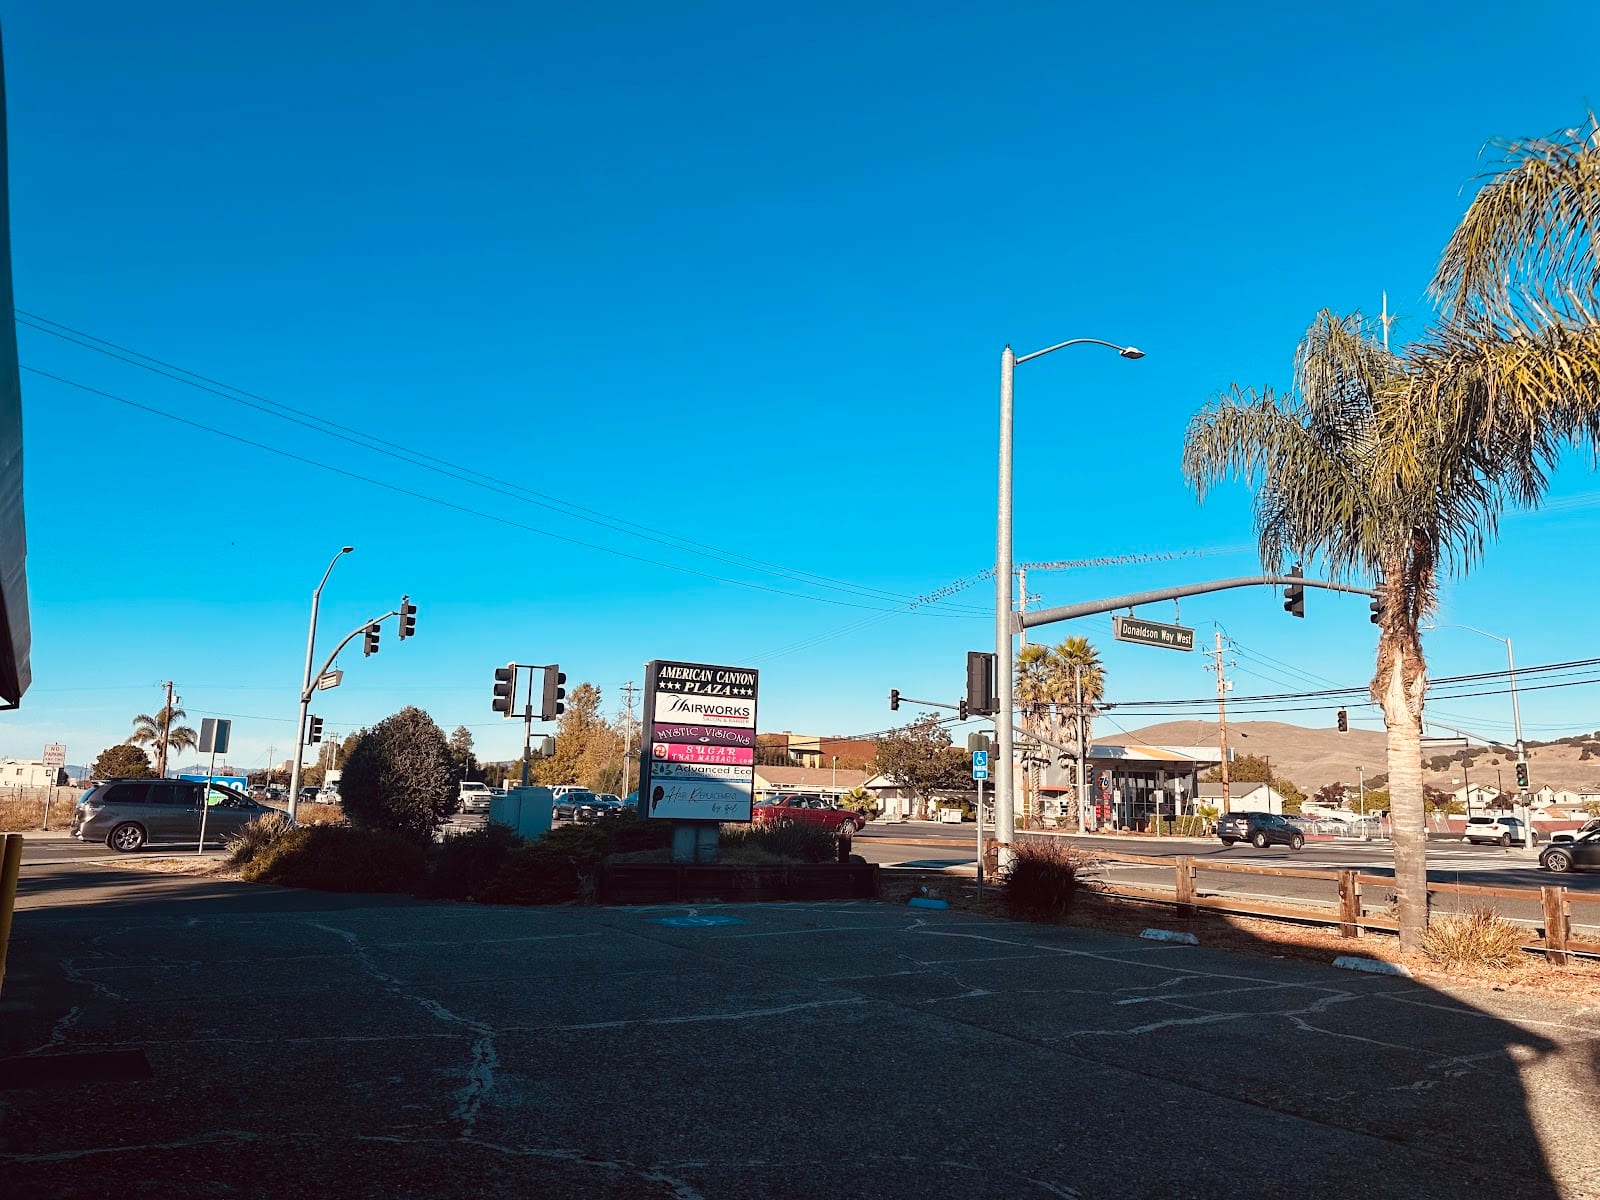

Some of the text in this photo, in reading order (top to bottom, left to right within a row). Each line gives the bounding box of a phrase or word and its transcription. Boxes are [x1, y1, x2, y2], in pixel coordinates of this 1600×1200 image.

[1122, 623, 1192, 645] Donaldson Way West
[659, 665, 755, 686] AMERICAN CANYON
[683, 681, 731, 696] PLAZA
[667, 695, 750, 717] HAIRWORKS
[657, 727, 751, 745] MYSTIC VISIONS
[685, 745, 737, 756] SUGAR
[675, 764, 752, 775] Advanced Eco
[1099, 777, 1109, 787] 76
